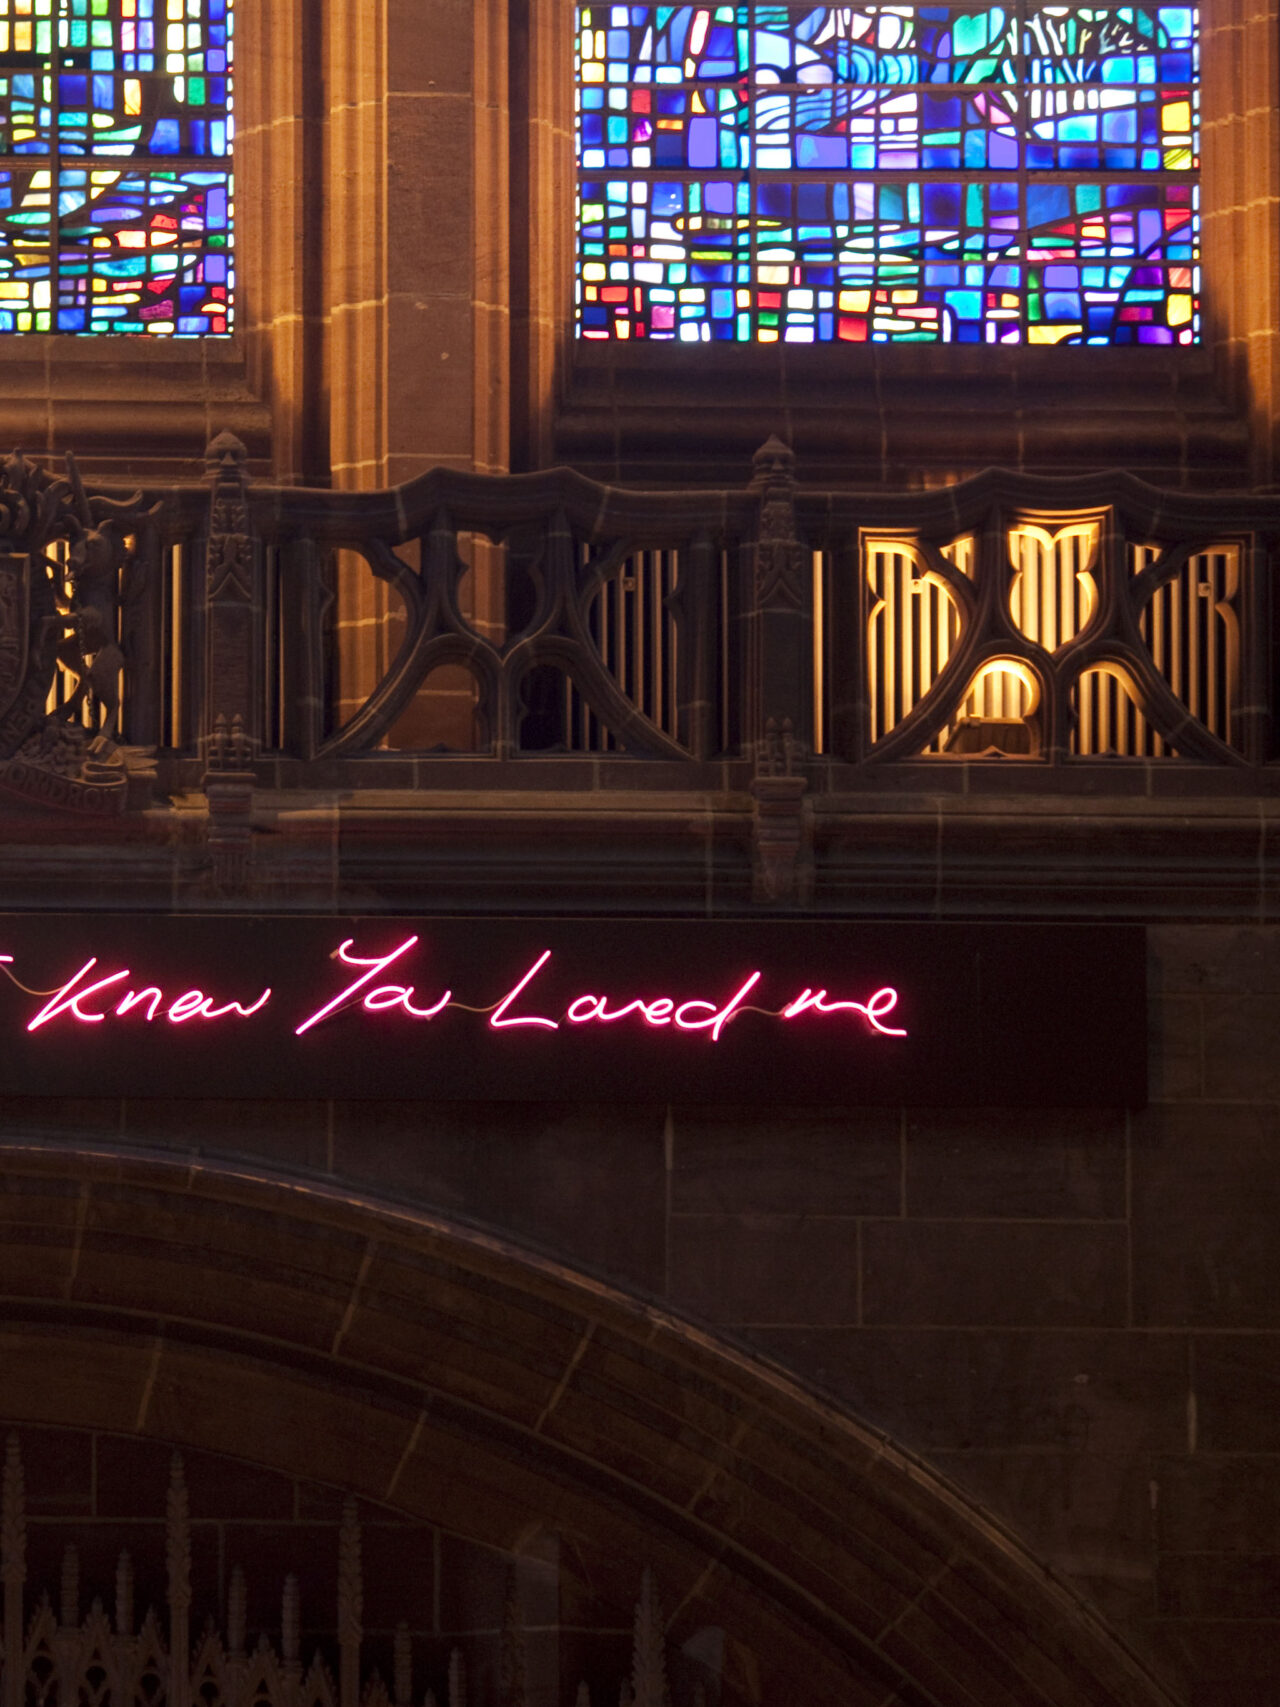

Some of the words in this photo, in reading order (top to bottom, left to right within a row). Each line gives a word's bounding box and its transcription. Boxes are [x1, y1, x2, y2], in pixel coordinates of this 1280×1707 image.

[27, 957, 272, 1031] Knew
[295, 935, 451, 1035] You
[490, 949, 761, 1042] Loved
[783, 986, 908, 1036] me
